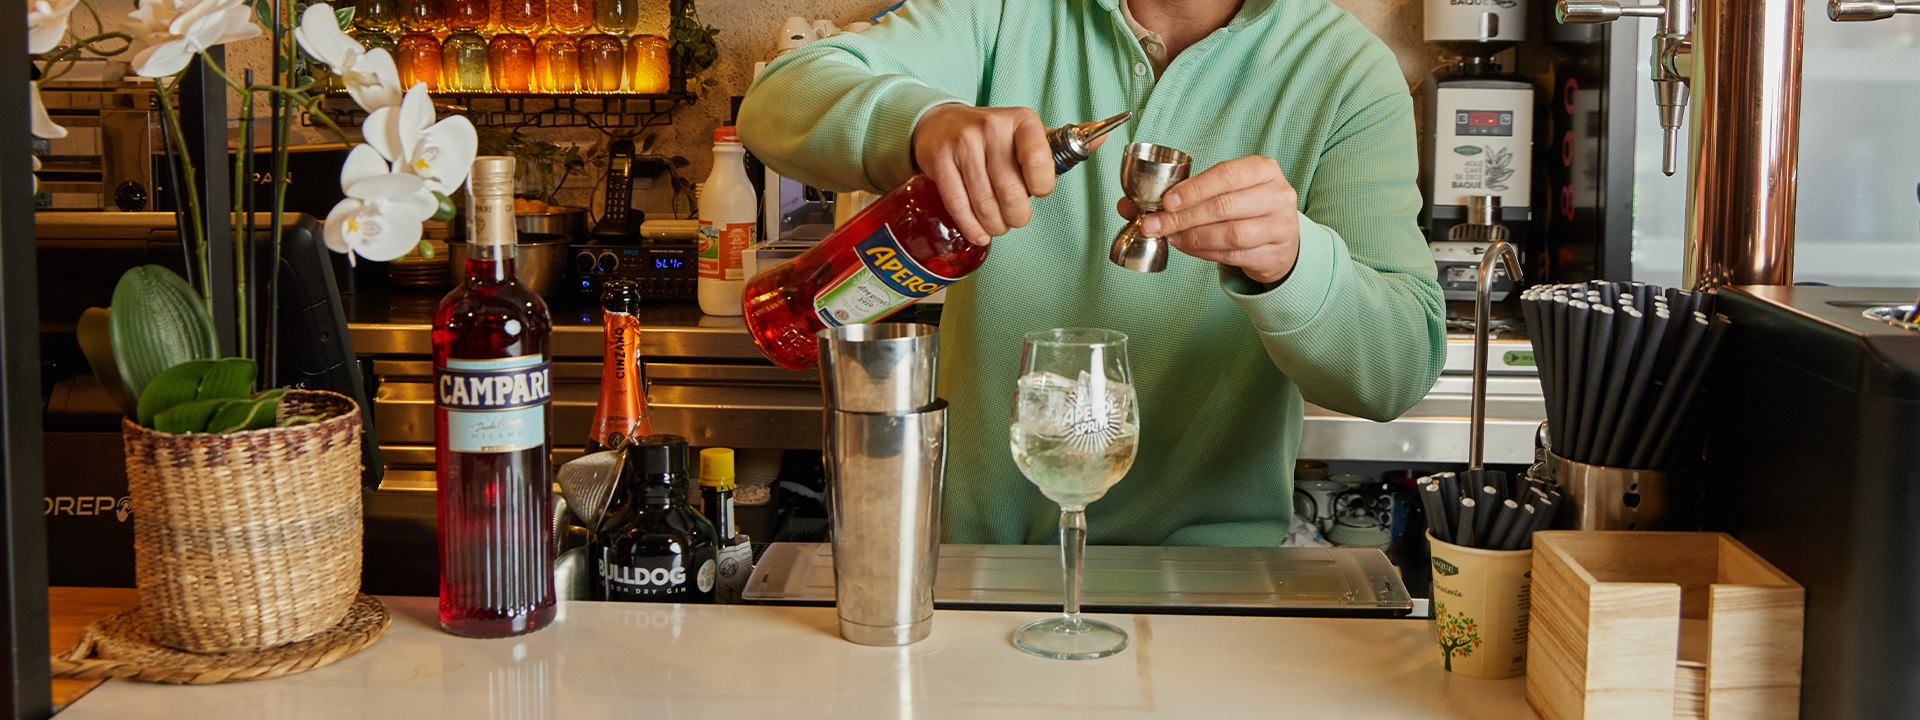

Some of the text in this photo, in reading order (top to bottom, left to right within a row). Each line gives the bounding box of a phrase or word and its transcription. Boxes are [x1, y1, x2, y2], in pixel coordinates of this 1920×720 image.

[614, 327, 626, 379] CINZANO
[440, 368, 551, 406] CAMPARI
[1062, 400, 1118, 427] APEOL
[471, 430, 525, 440] MILANO
[598, 558, 687, 587] BULLDOG
[666, 586, 687, 595] GIN
